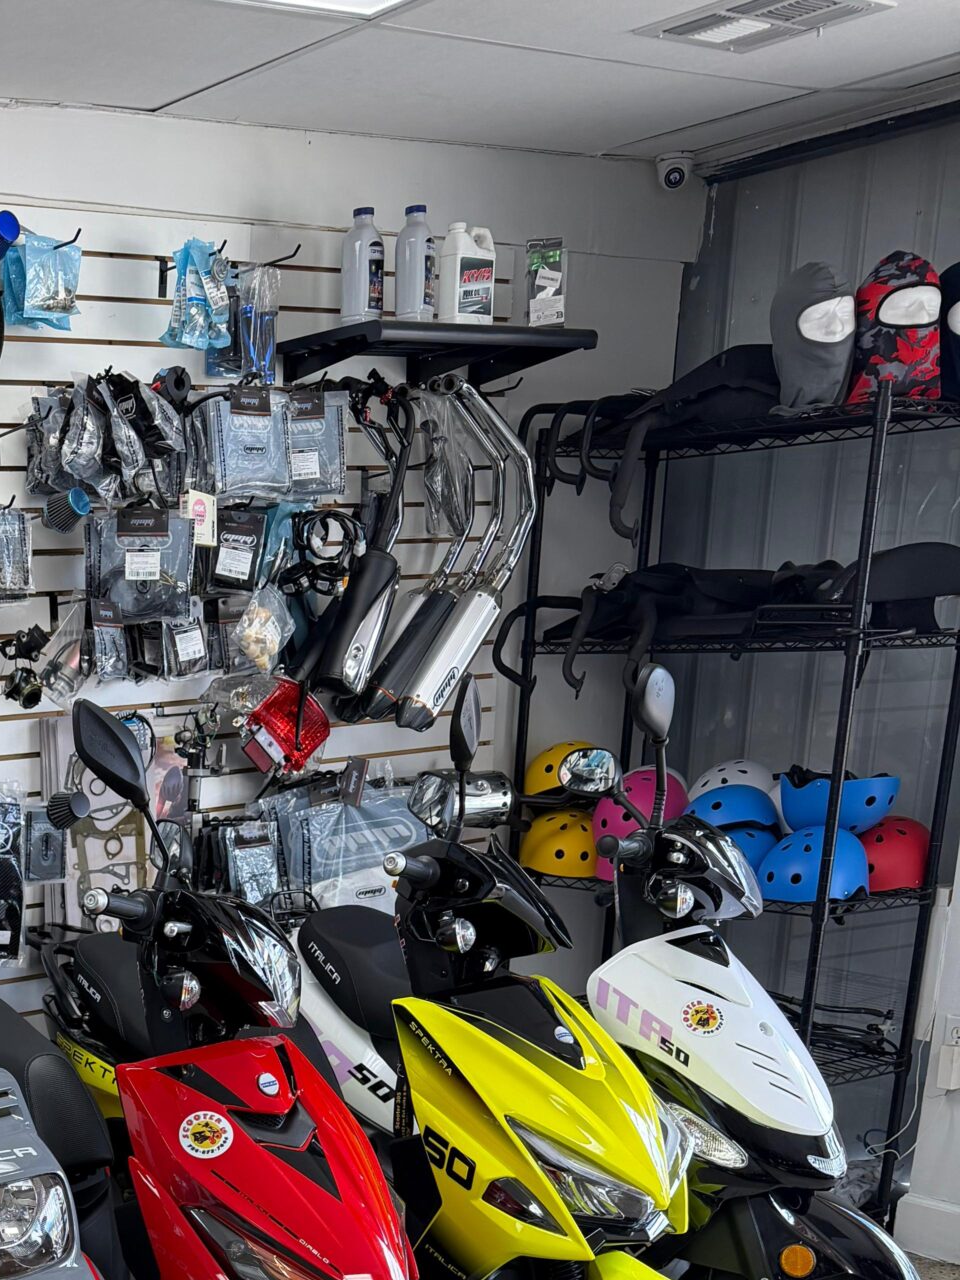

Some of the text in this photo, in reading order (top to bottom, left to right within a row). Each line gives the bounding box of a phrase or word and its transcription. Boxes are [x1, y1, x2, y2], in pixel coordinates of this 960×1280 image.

[463, 267, 493, 284] KYB
[307, 940, 341, 985] ITALICA
[77, 973, 102, 1003] ITALICA
[596, 976, 690, 1068] ITA 50
[56, 1031, 117, 1085] SPEKT
[408, 1020, 454, 1077] SPEKTRA
[348, 1062, 397, 1104] 50
[182, 1113, 222, 1139] SCOOTER
[422, 1124, 477, 1192] 50
[298, 1237, 331, 1265] DIABLO
